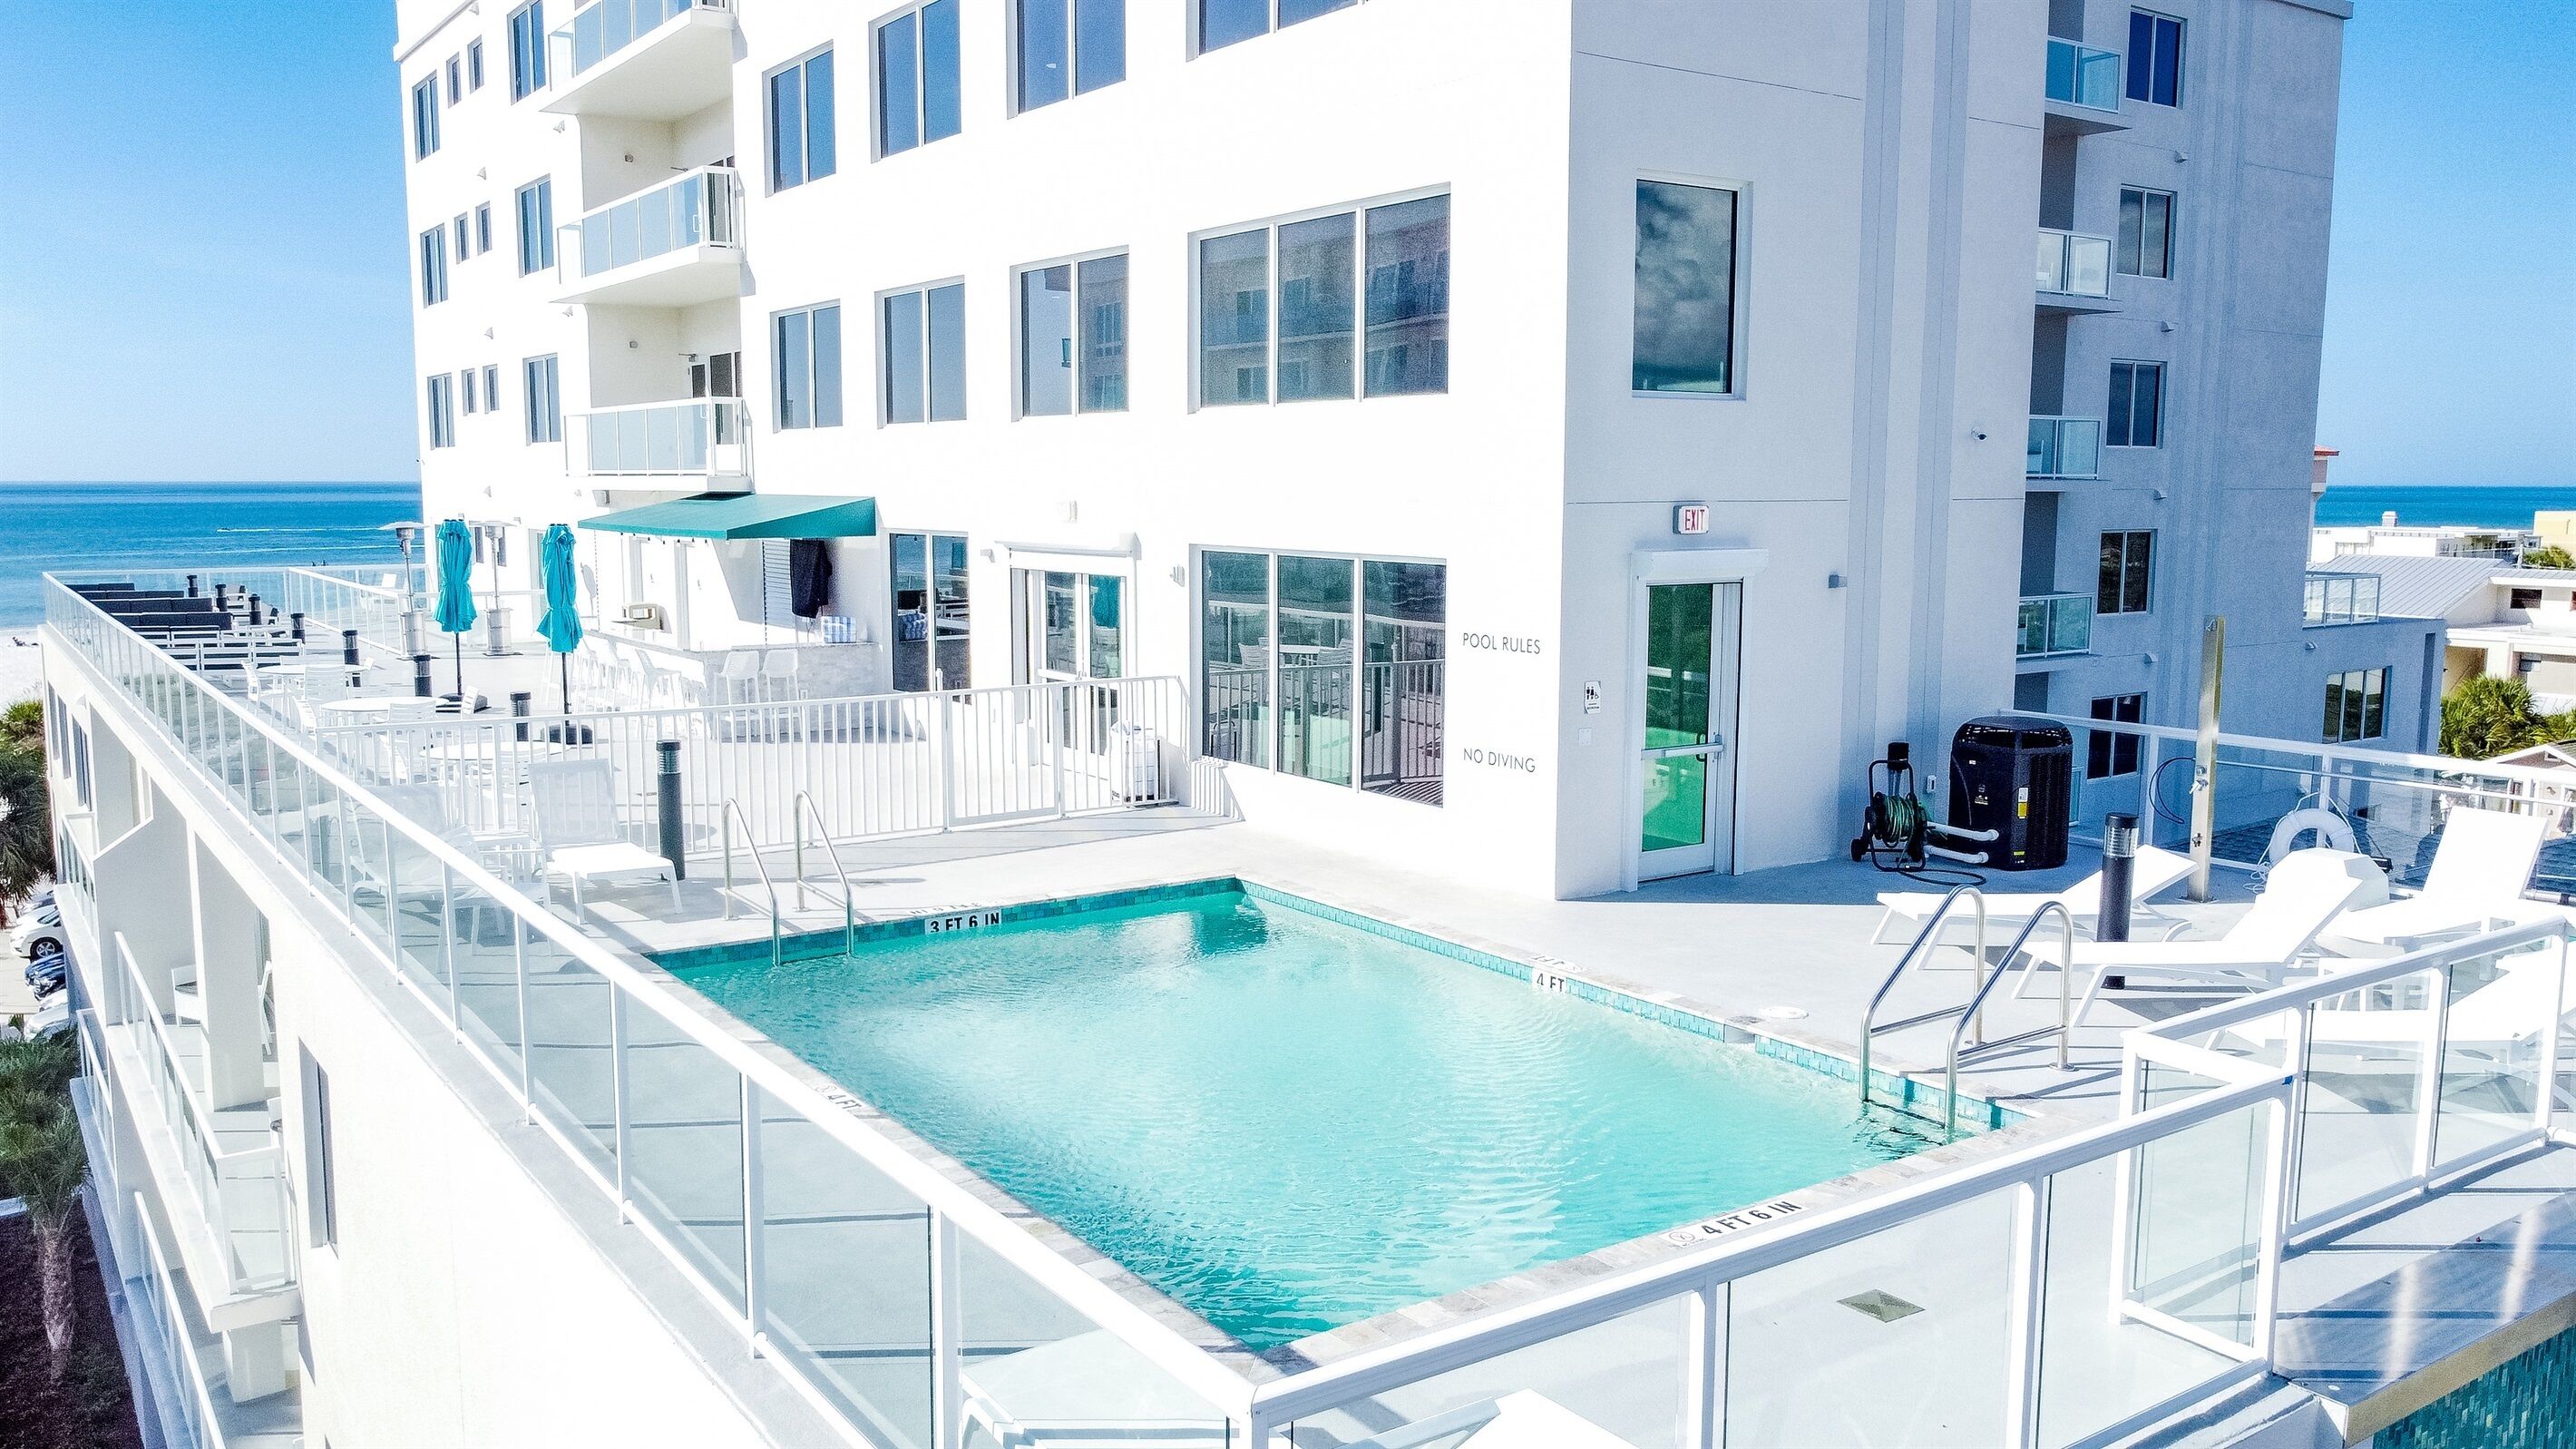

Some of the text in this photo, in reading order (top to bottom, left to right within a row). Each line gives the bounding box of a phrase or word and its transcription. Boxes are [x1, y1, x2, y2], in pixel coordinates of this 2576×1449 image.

[1684, 509, 1705, 531] EXIT
[1462, 632, 1541, 654] POOL RULES
[1463, 748, 1536, 773] NO DIVING
[930, 912, 1000, 933] 3 FT 6 IN
[1537, 973, 1566, 993] 4 FT
[1701, 1200, 1802, 1235] 4 FT 6 IN
